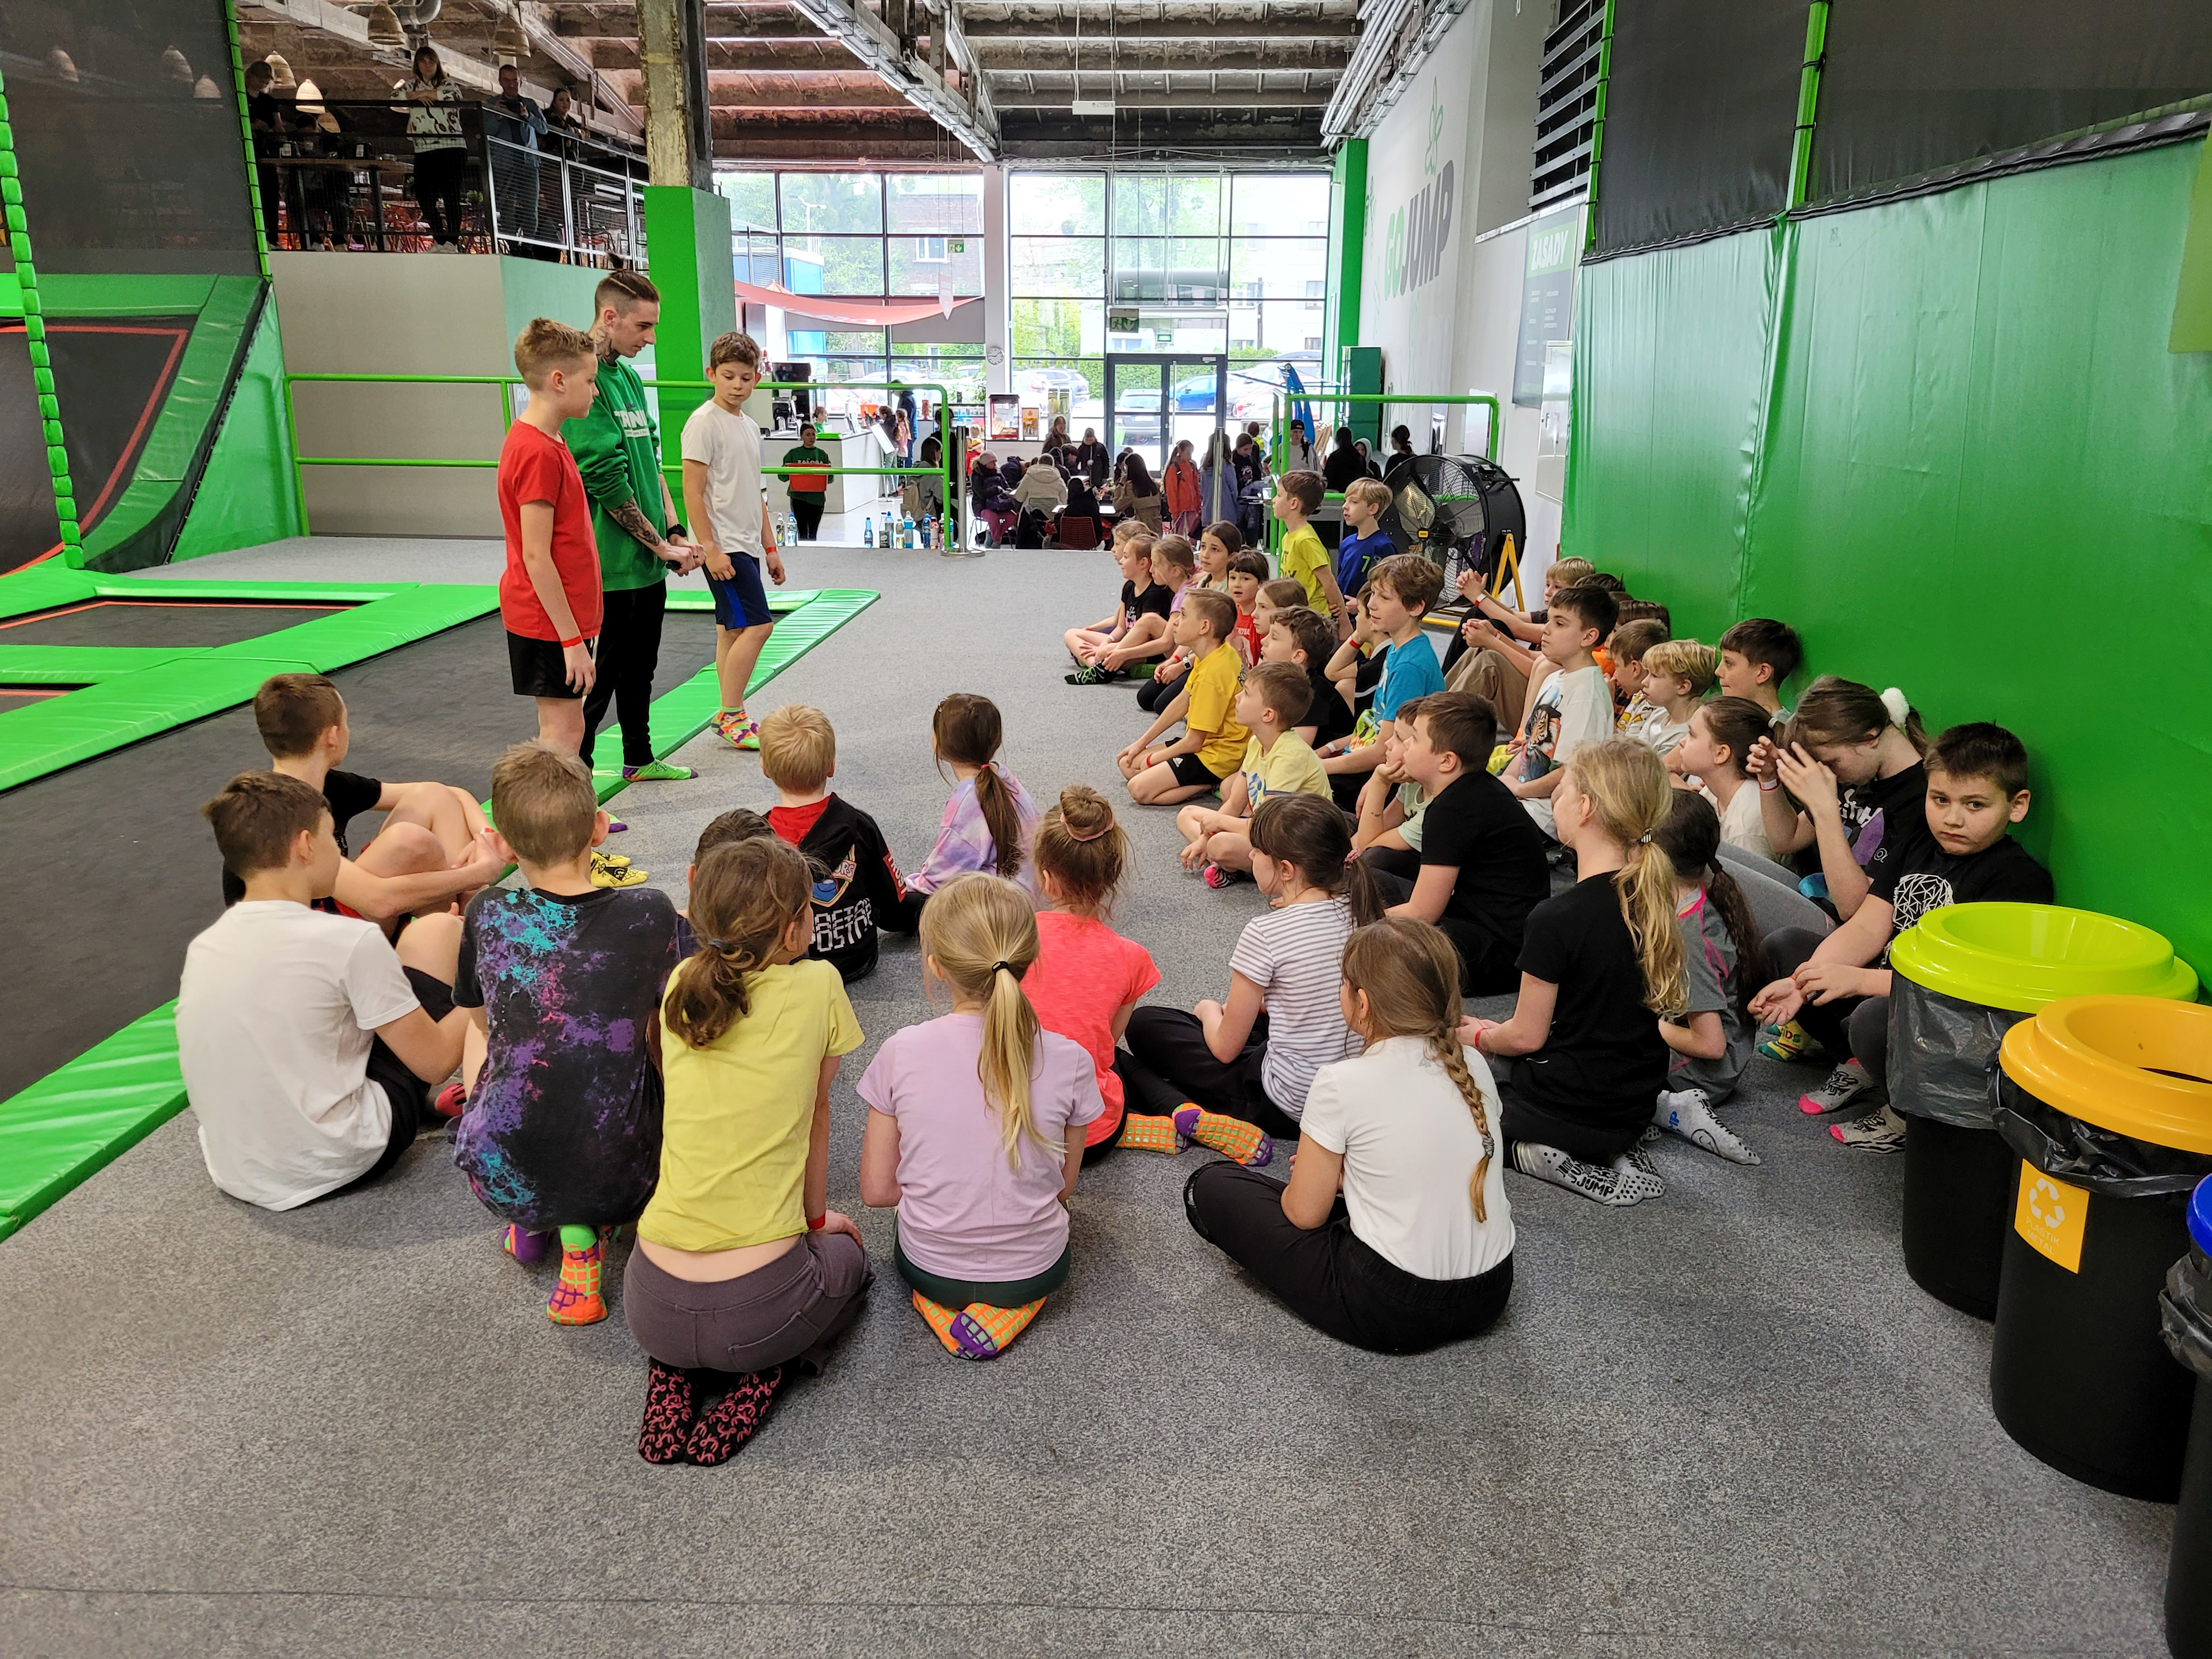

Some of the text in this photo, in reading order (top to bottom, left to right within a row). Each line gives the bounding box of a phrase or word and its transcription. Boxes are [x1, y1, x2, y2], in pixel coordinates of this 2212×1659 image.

[1531, 229, 1569, 271] ZASADY
[1361, 555, 1370, 573] 7
[2026, 1216, 2060, 1247] PLASTIK
[2027, 1229, 2055, 1256] METAL
